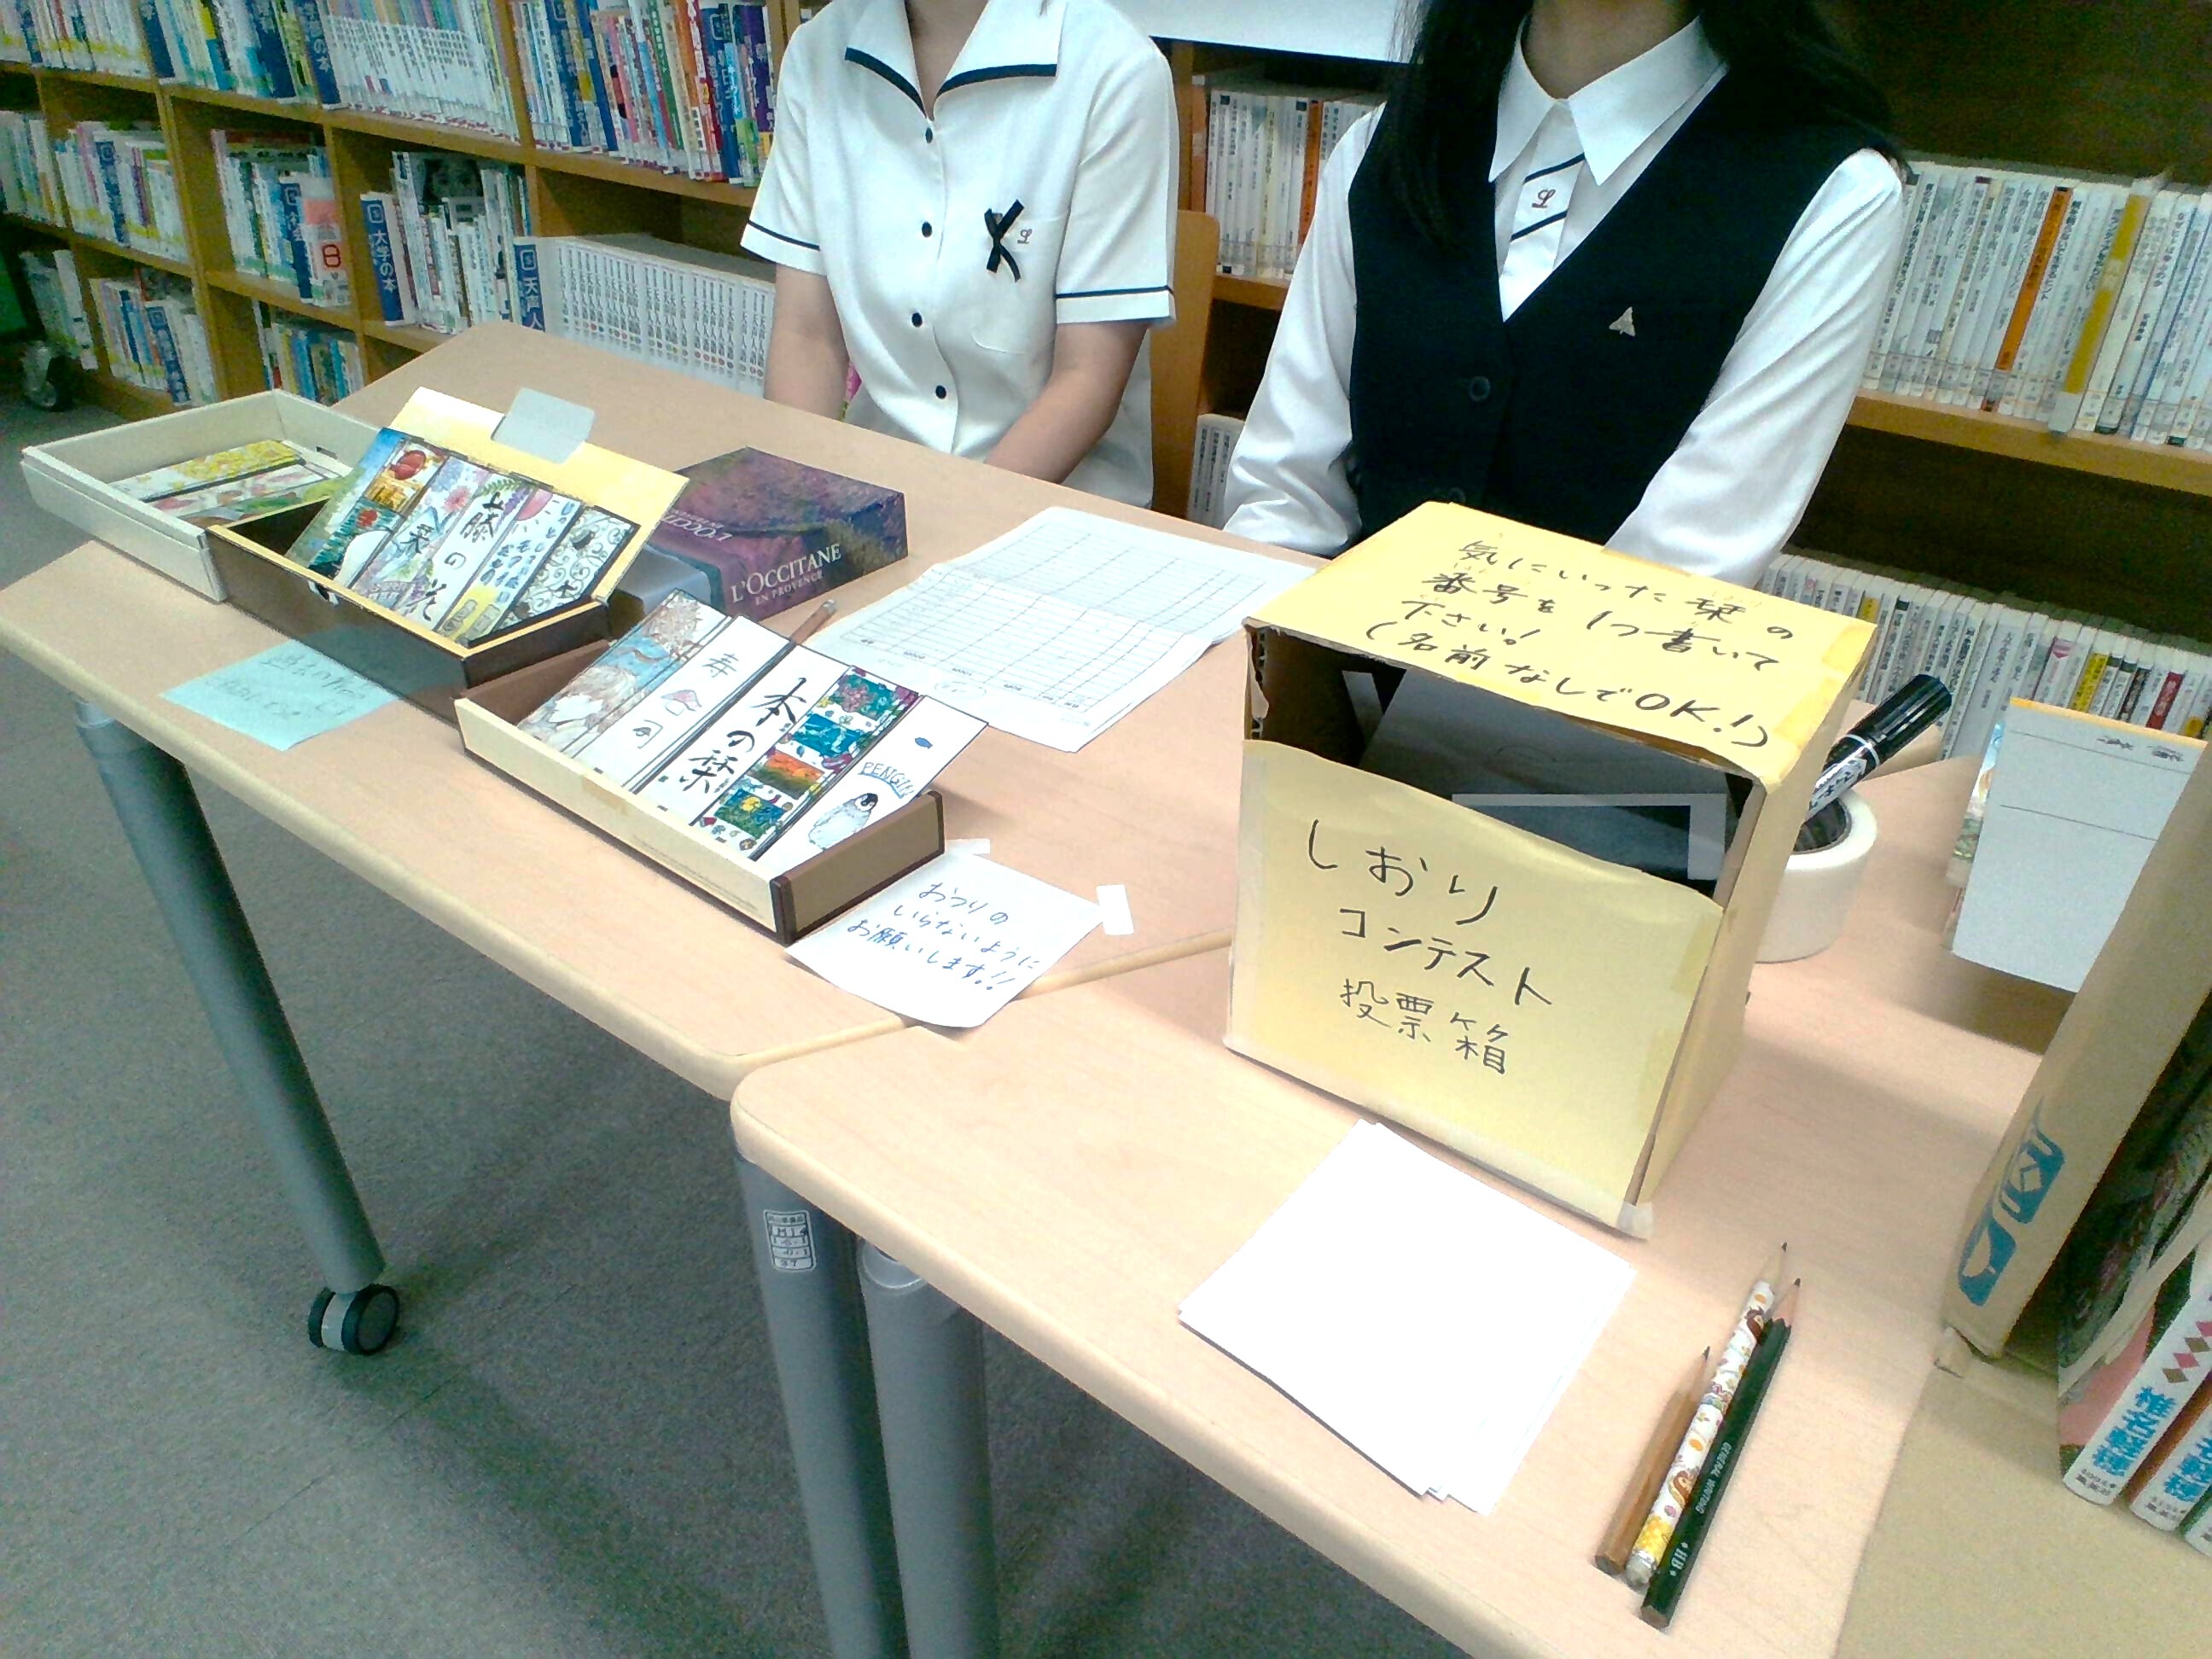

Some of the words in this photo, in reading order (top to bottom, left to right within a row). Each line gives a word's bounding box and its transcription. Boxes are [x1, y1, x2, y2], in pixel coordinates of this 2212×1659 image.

[373, 230, 397, 293] 大学の本
[730, 544, 842, 602] L'OCCITANE
[755, 594, 770, 605] EN
[771, 570, 824, 598] PROVENCE
[682, 677, 808, 795] 本の栞
[1307, 818, 1499, 926] しおり
[1339, 907, 1553, 1006] コンテスト
[1339, 978, 1509, 1075] 投票箱
